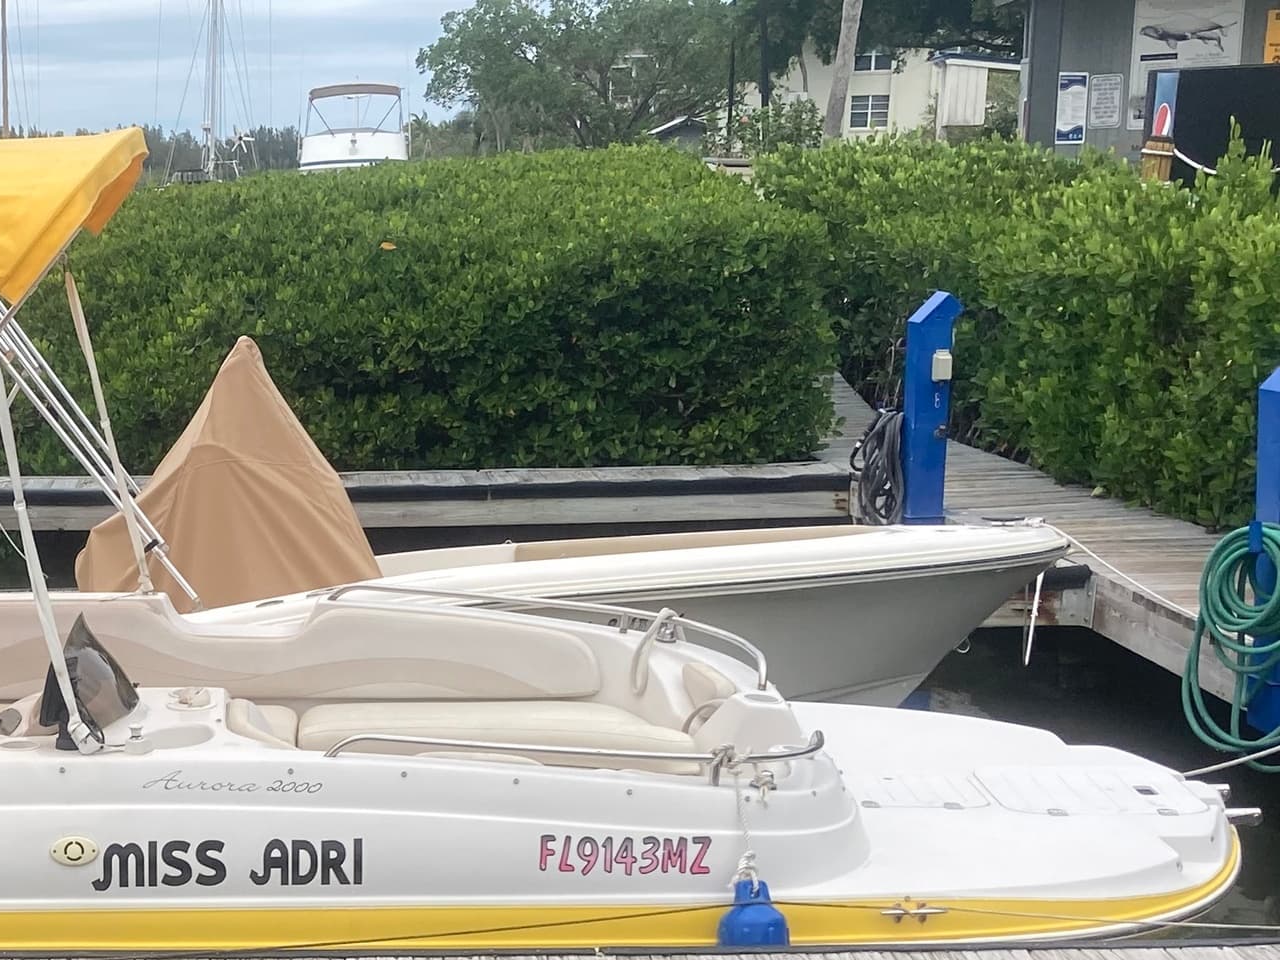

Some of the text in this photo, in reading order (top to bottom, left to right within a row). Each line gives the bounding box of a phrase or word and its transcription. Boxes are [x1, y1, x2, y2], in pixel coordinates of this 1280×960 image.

[142, 769, 323, 794] Aurora 2000
[91, 838, 363, 892] MISS ADRI
[539, 834, 713, 877] FL9143MZ
